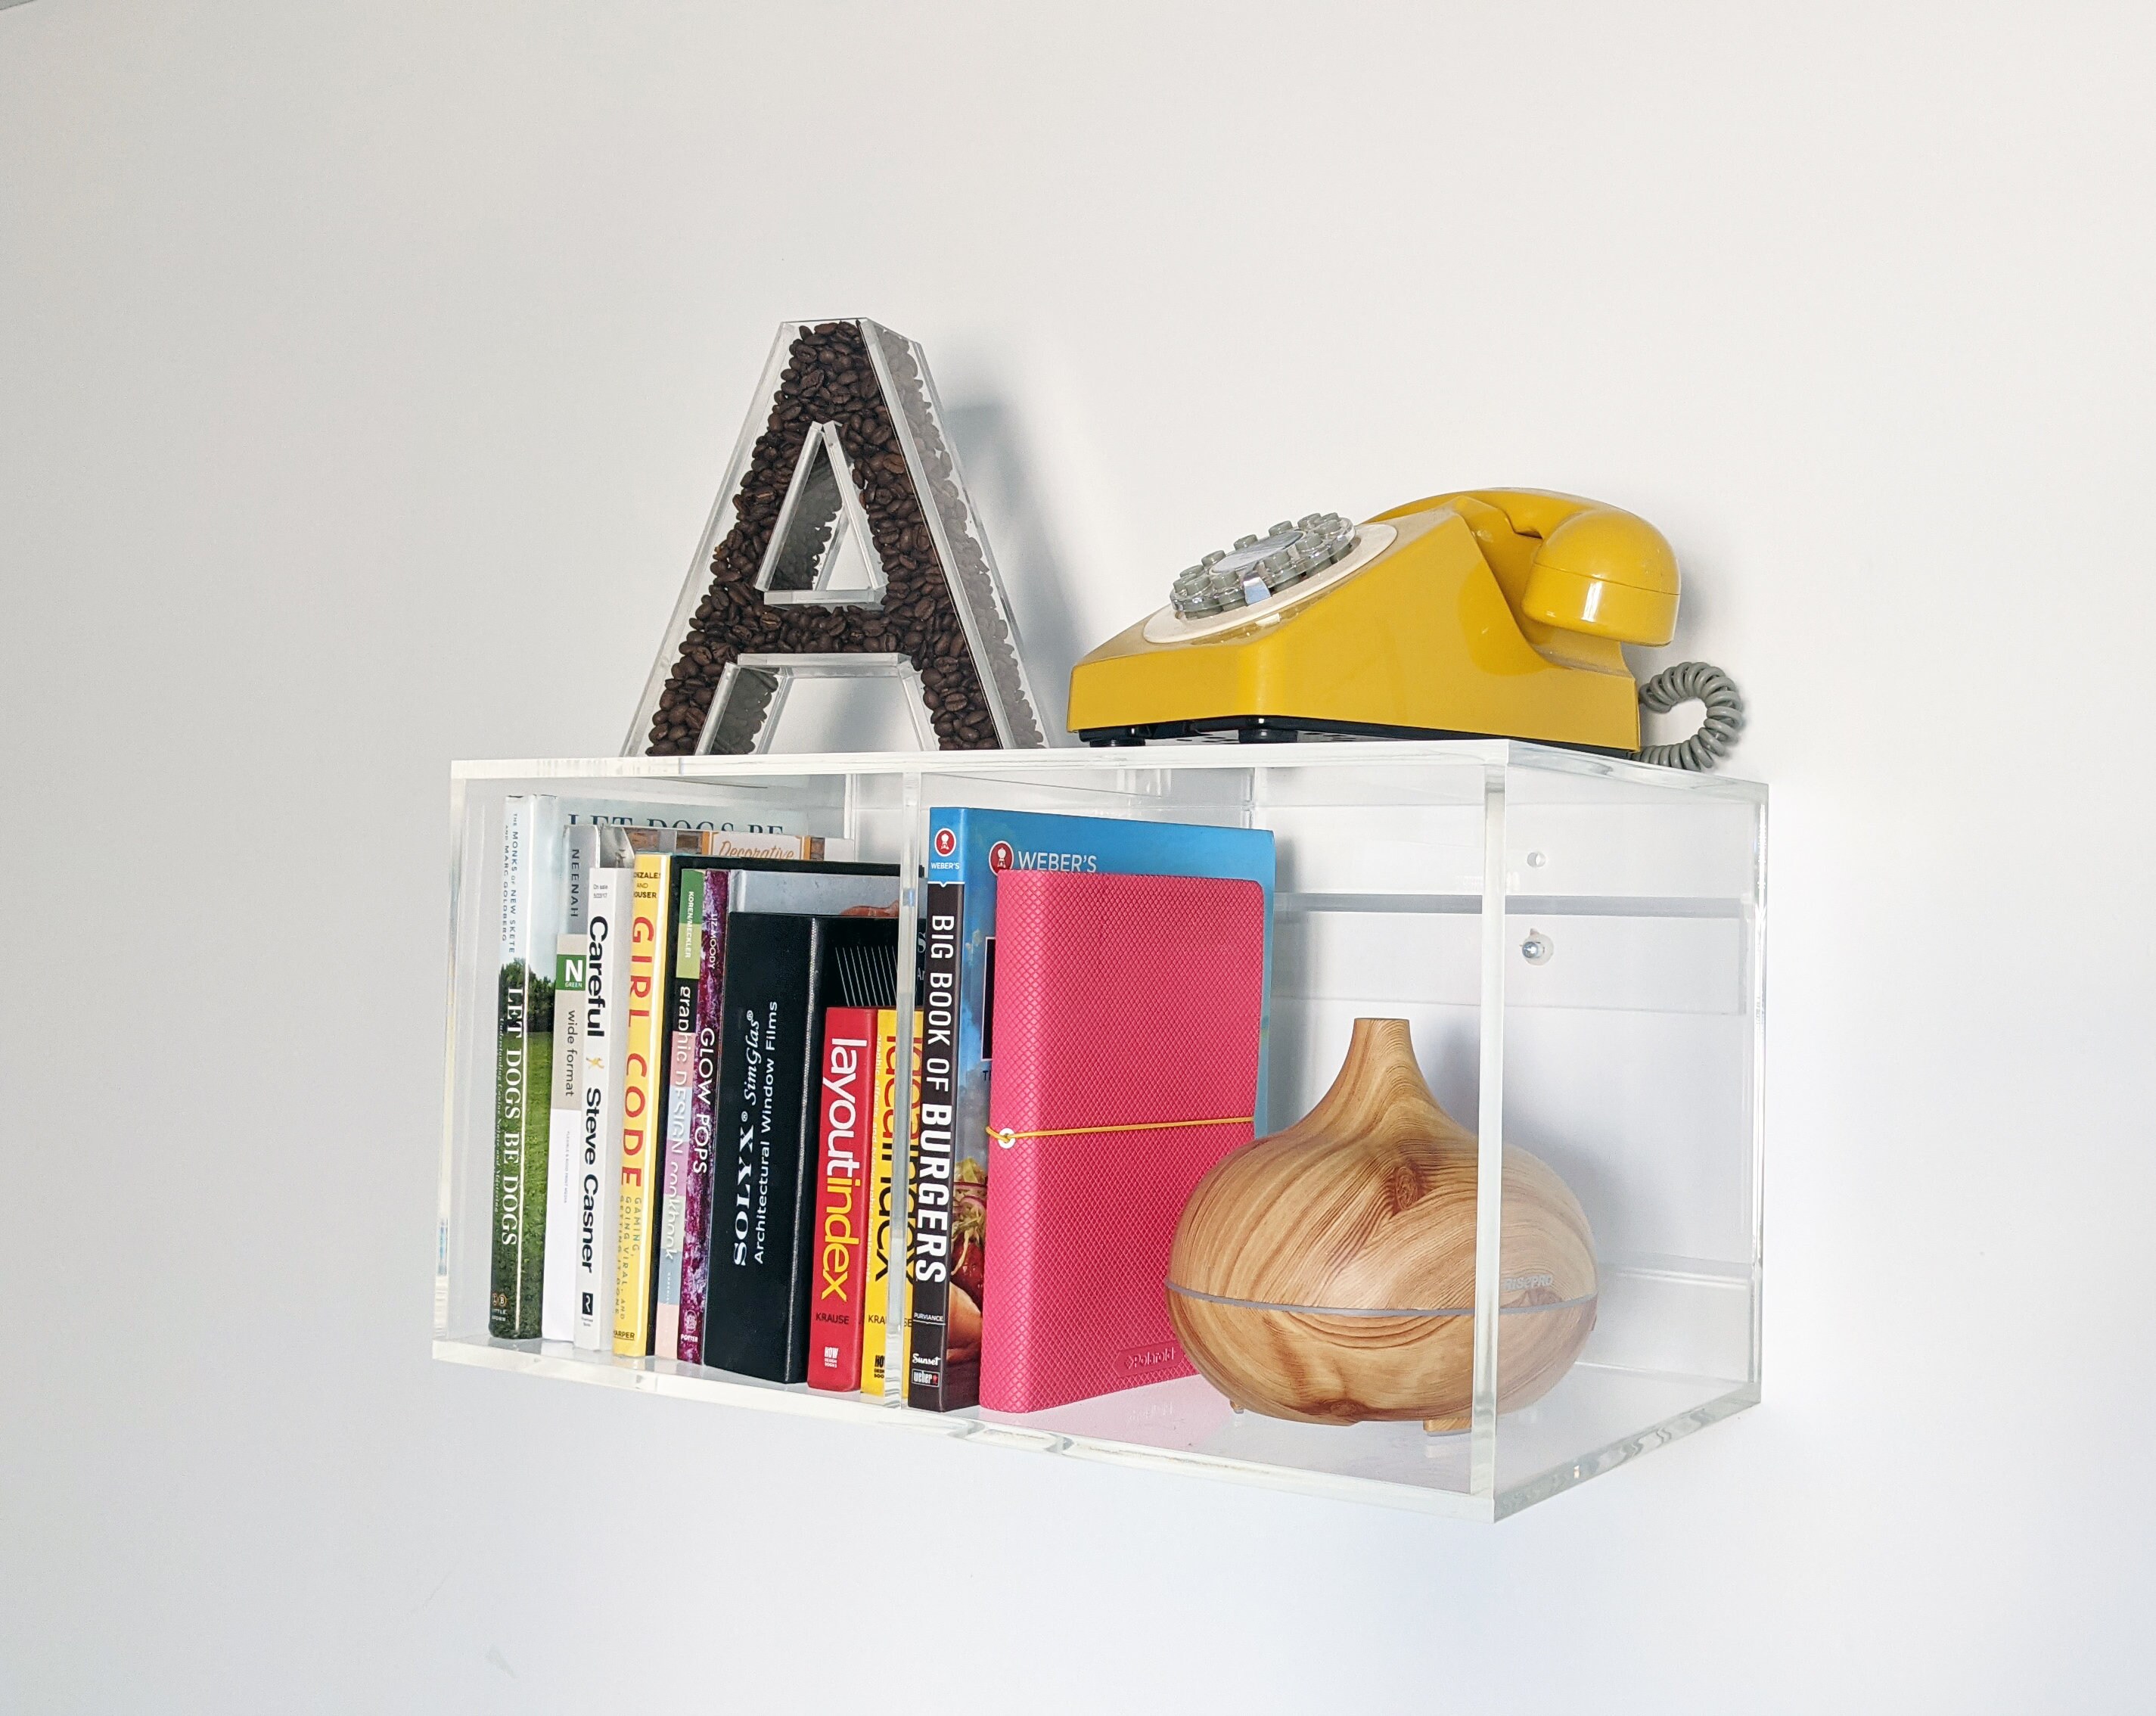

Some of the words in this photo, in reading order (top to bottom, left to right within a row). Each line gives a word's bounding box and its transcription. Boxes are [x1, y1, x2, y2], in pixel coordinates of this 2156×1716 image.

[719, 841, 794, 860] Decorative
[511, 875, 515, 884] OF
[570, 849, 580, 917] NEENAH
[685, 891, 694, 959] KOREN/MECKLER
[710, 913, 718, 930] LIZ
[930, 915, 955, 959] BIG
[565, 959, 583, 982] N
[628, 916, 654, 1027] GIRL
[708, 931, 717, 969] MOODY
[587, 916, 608, 1037] Careful
[507, 987, 523, 1039] LET
[567, 1010, 578, 1044] wide
[676, 986, 691, 1062] graphic
[766, 1001, 778, 1051] Films
[927, 971, 953, 1046] BOOK
[505, 1049, 522, 1119] DOGS
[565, 1049, 578, 1096] format
[697, 1027, 715, 1105] GLOW
[925, 1059, 951, 1092] OF
[621, 1052, 648, 1187] CODE
[671, 1071, 687, 1154] DESIGN
[761, 1058, 775, 1133] Window
[503, 1132, 520, 1164] BE
[584, 1087, 601, 1165] Steve
[692, 1113, 710, 1174] POPS
[502, 1175, 519, 1245] DOGS
[623, 1196, 632, 1239] GOING
[754, 1141, 770, 1264] Architectural
[915, 1103, 952, 1284] BURGERS
[582, 1174, 599, 1274] Casner
[631, 1197, 642, 1257] GAMING,
[815, 1312, 850, 1325] KRAUSE
[913, 1312, 944, 1322] PURVIANCE
[824, 1346, 839, 1359] HOW
[875, 1354, 885, 1368] HO
[912, 1353, 941, 1366] Sunset
[913, 1370, 933, 1385] weber
[1134, 1347, 1174, 1368] Polaroid
